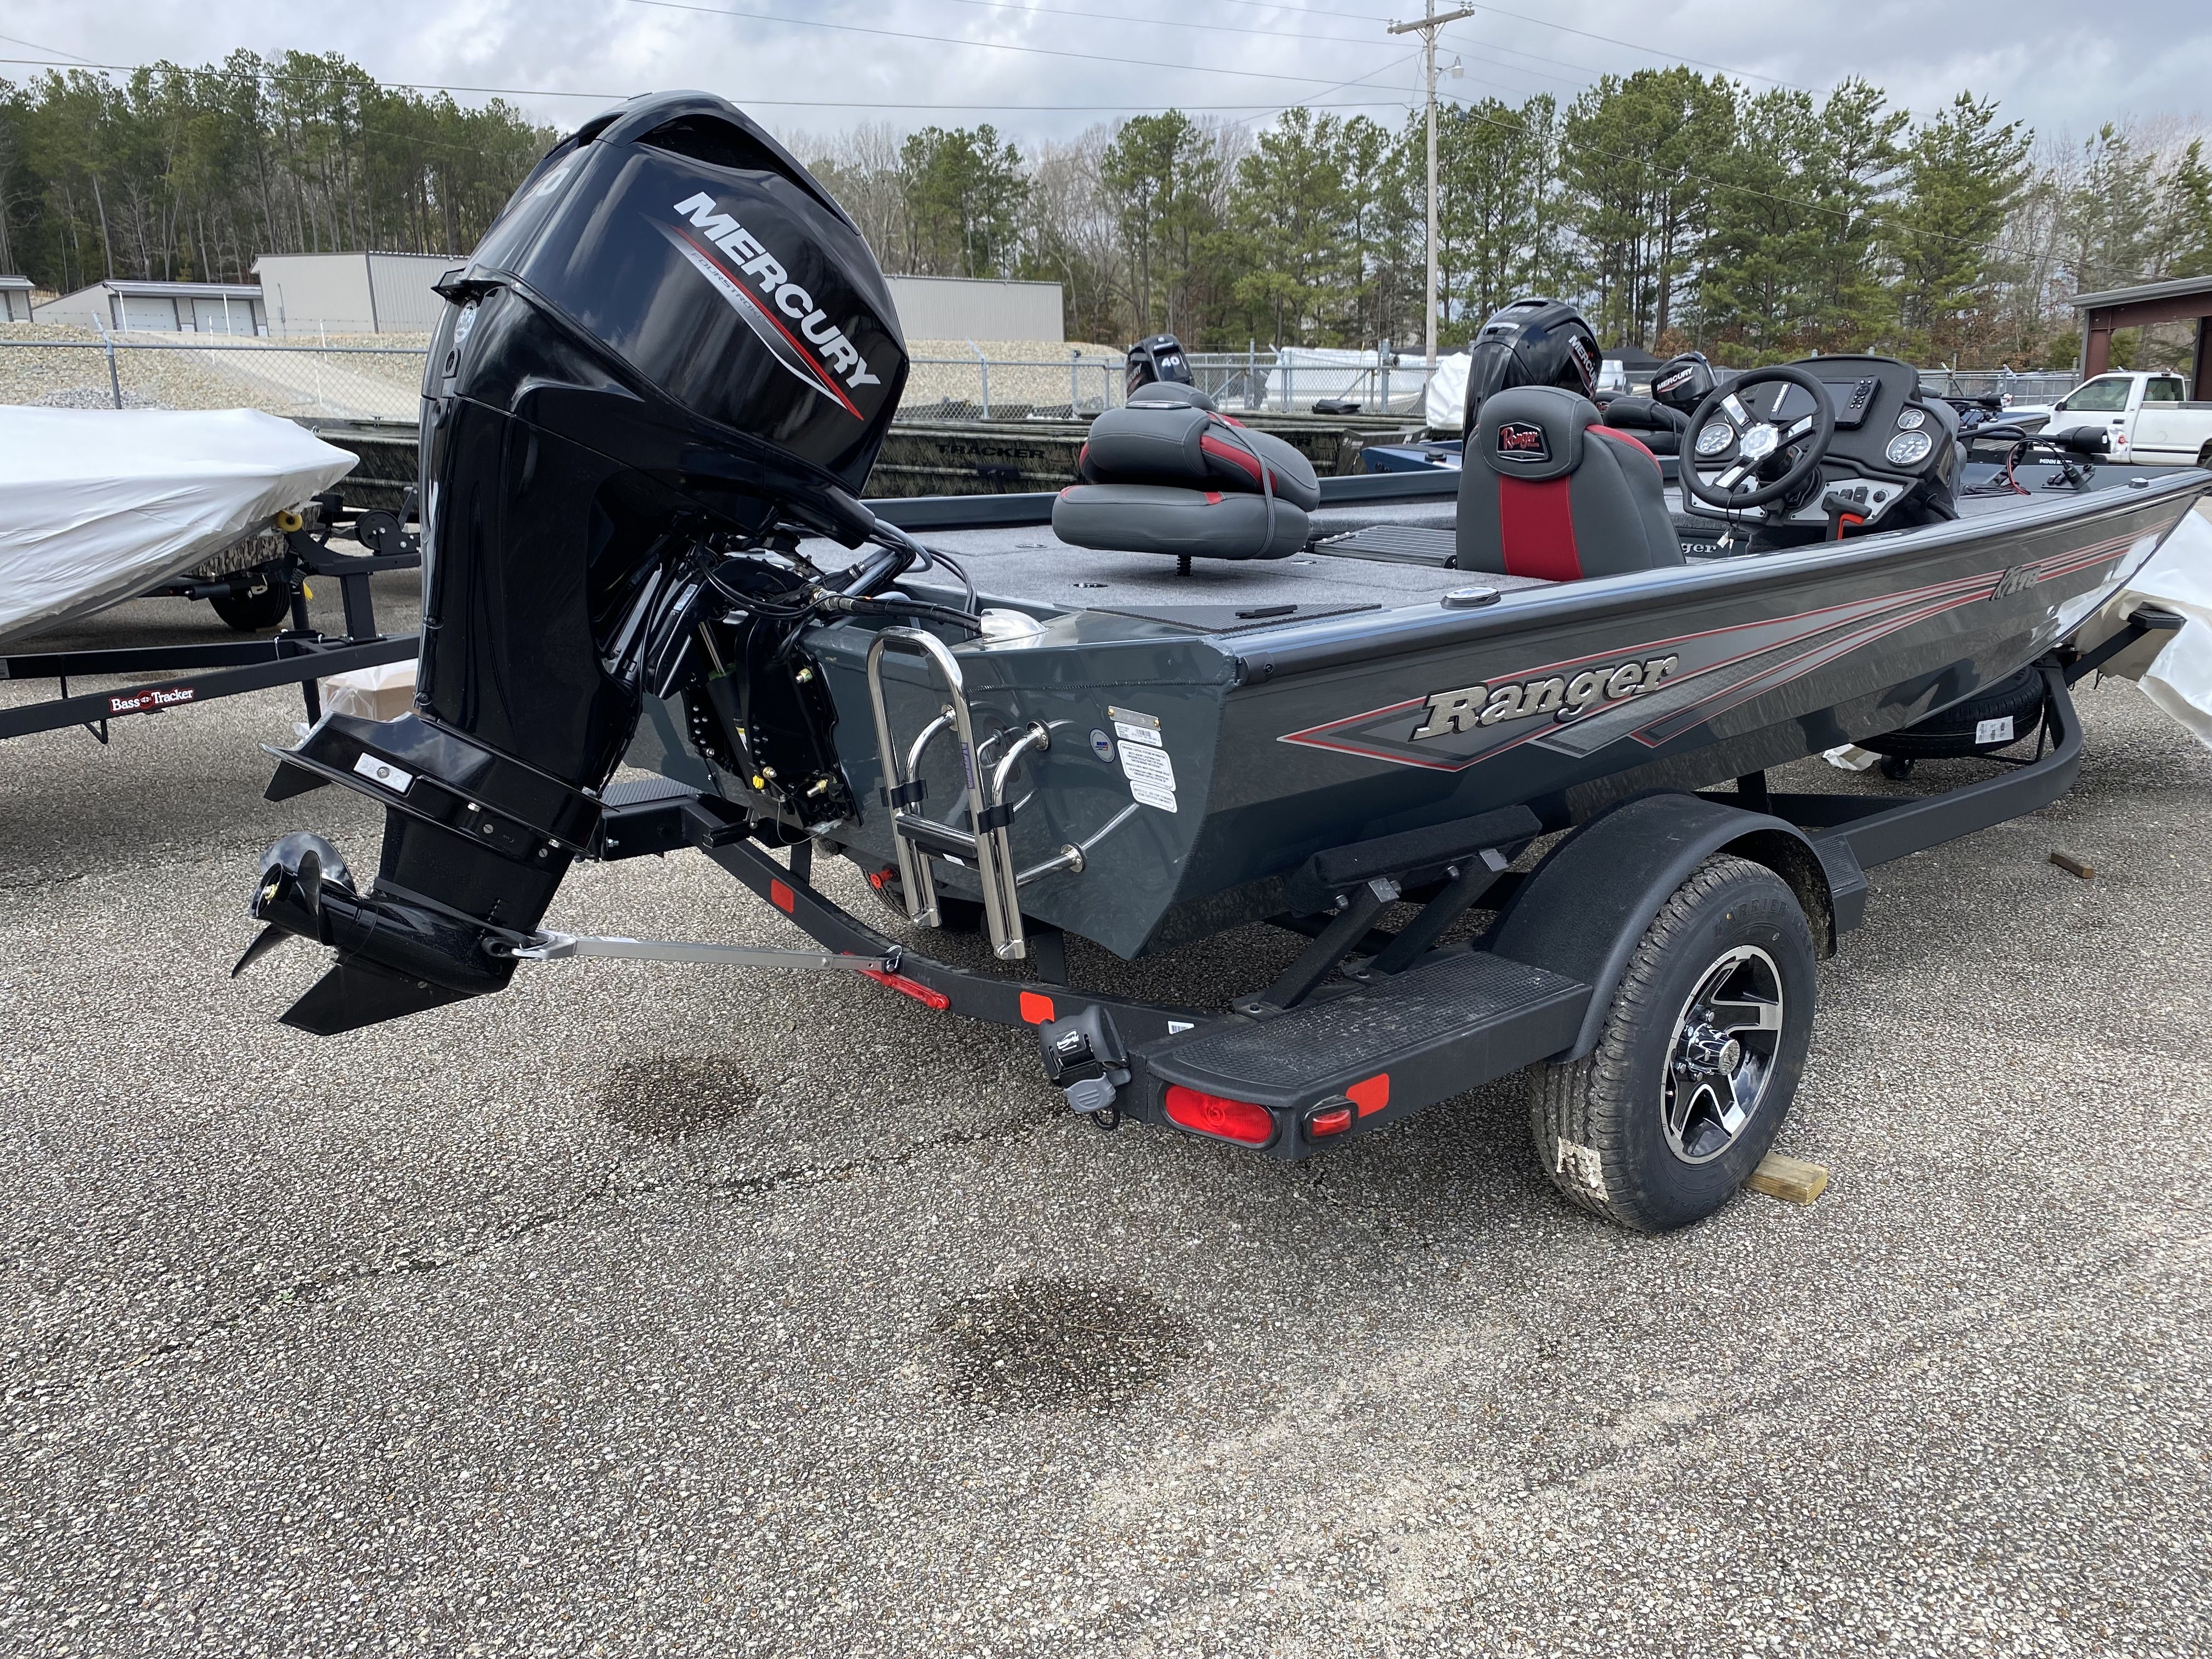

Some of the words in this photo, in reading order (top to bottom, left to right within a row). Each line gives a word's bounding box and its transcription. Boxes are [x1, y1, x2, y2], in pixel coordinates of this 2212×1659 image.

[673, 191, 881, 388] MERCURY
[691, 251, 767, 322] FOURSTROKE
[1161, 356, 1180, 368] 40
[1568, 334, 1599, 387] MERCUR
[1656, 366, 1694, 392] MERCURY
[935, 444, 1046, 459] TRACKER
[1681, 542, 1718, 554] ger
[111, 698, 140, 712] Bass
[151, 689, 193, 704] Tracker
[1412, 653, 1679, 741] Ranger
